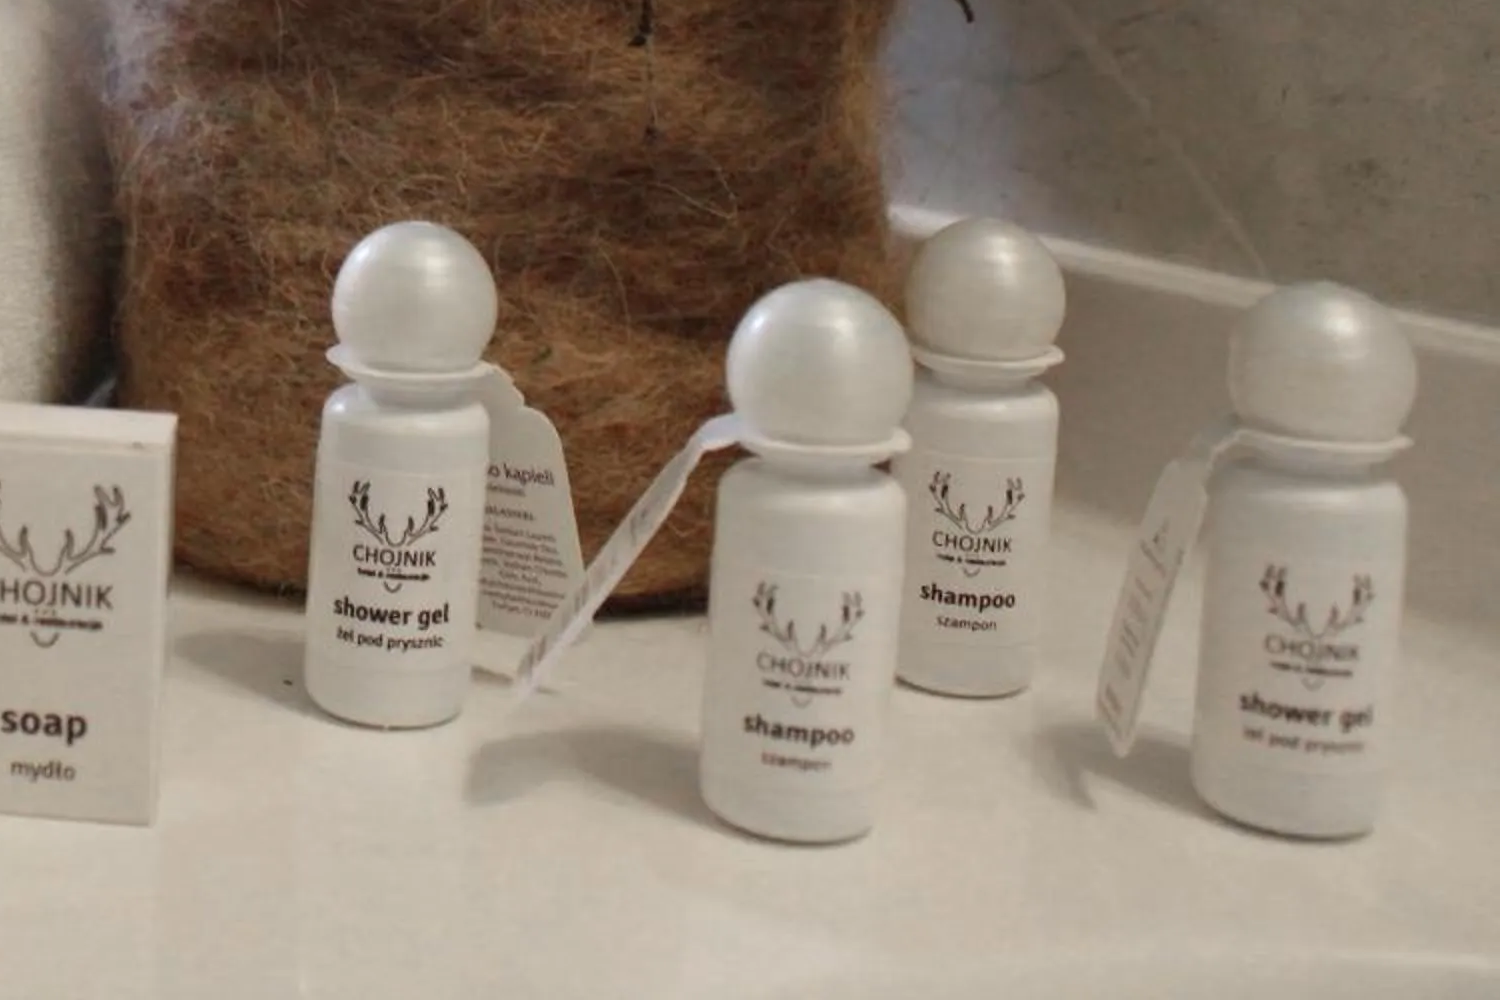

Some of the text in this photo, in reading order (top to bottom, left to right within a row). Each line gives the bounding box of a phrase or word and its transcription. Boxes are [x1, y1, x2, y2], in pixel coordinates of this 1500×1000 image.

[352, 543, 436, 567] CHOJNIK
[932, 530, 1012, 553] CHOJNIK
[333, 595, 449, 630] shower gel
[919, 582, 1016, 613] shampoo
[357, 633, 383, 648] pod
[756, 651, 852, 681] CHOJNIK
[1239, 691, 1334, 727] shower
[0, 709, 88, 747] soap
[743, 712, 855, 750] shampoo
